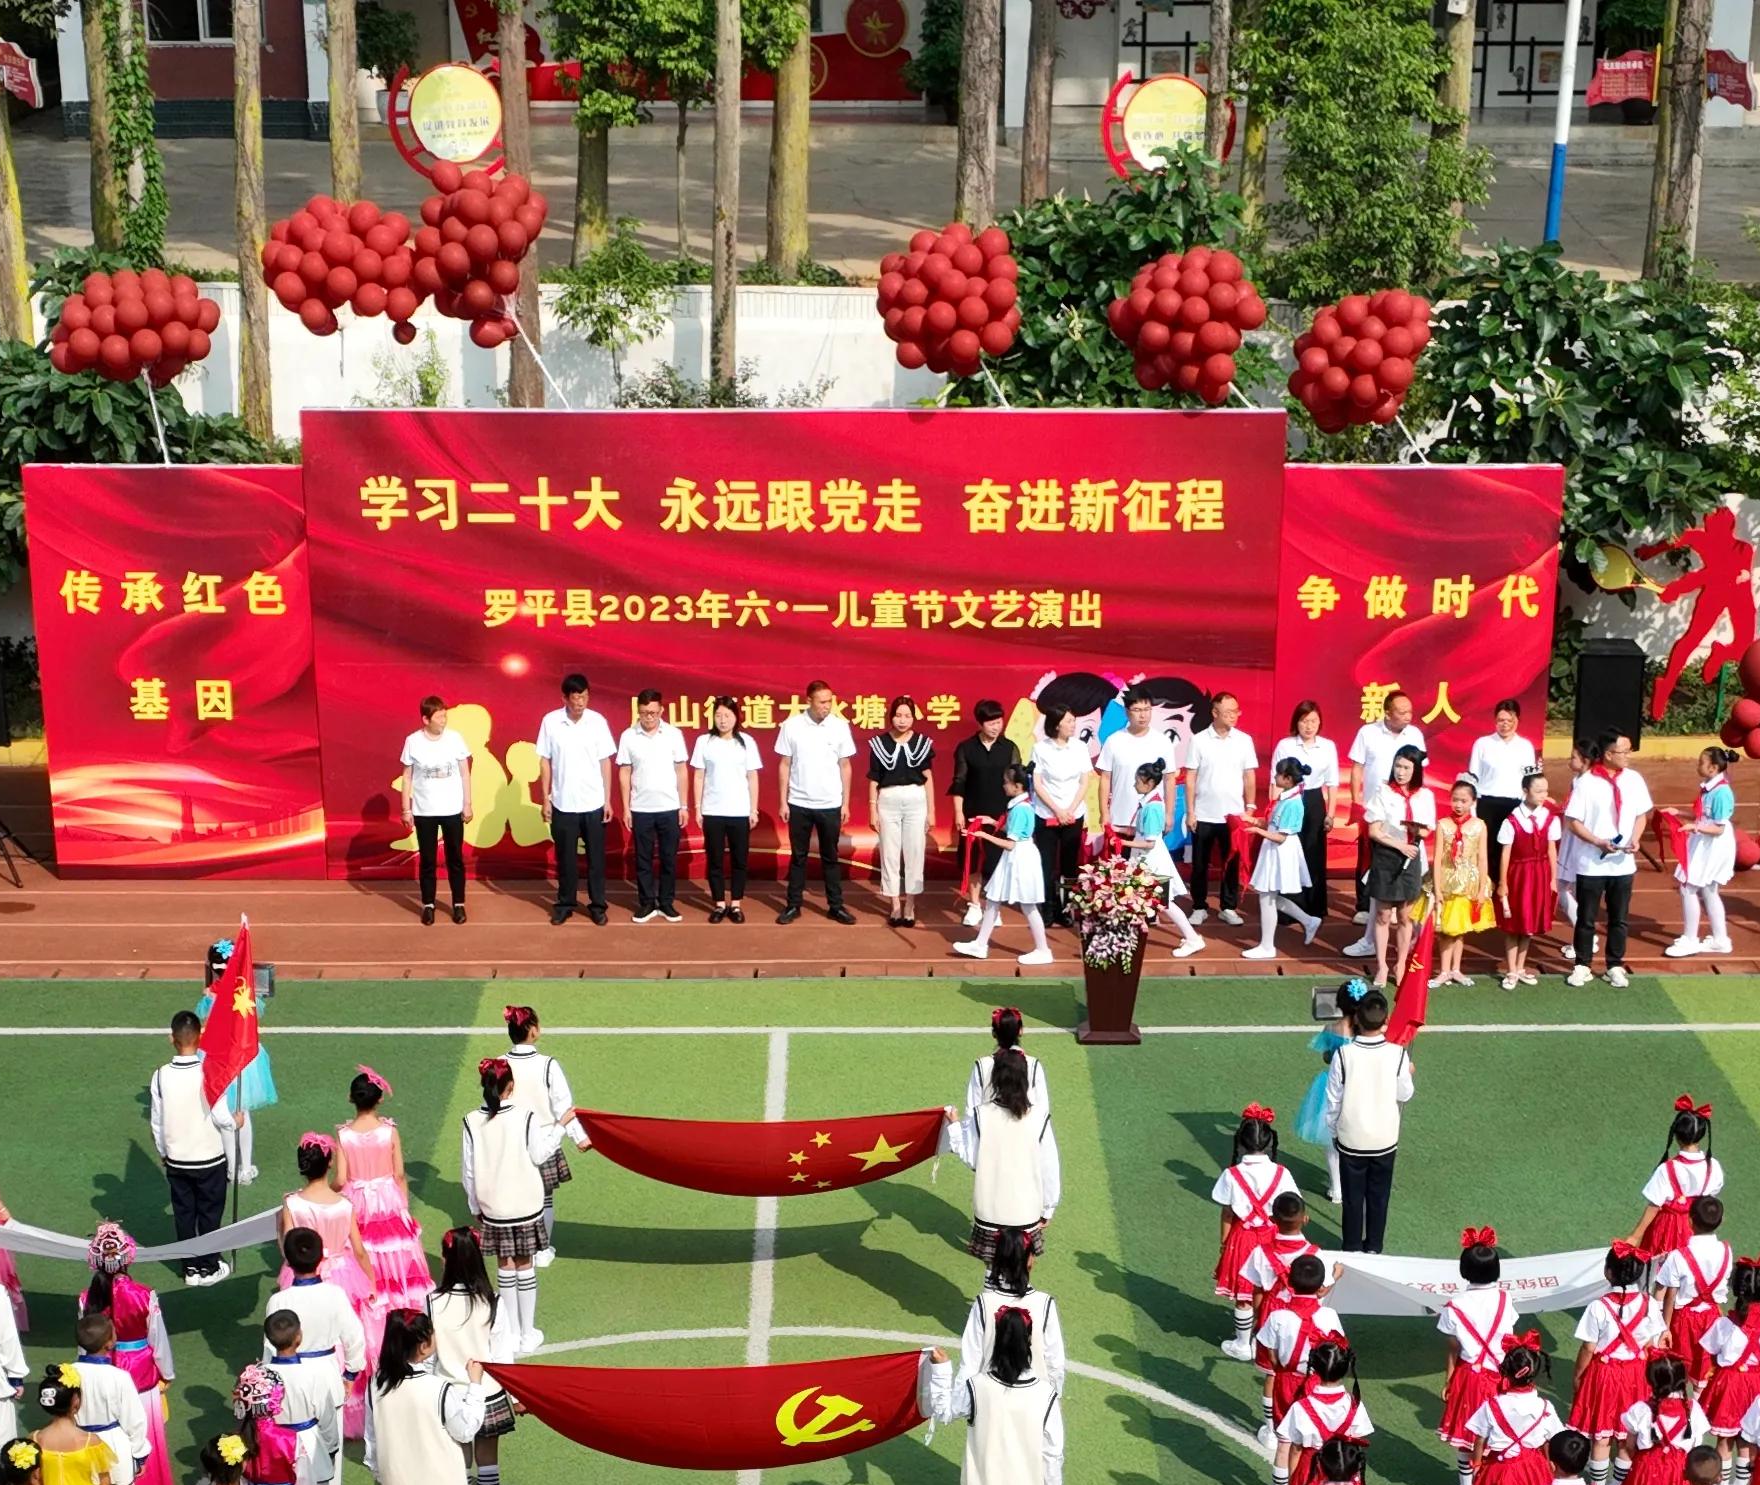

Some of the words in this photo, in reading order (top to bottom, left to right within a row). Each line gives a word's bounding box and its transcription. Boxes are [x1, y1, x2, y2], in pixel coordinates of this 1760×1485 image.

[359, 475, 622, 532] 学习二十大
[660, 476, 922, 533] 永远跟党走
[962, 478, 1225, 533] 奋进新征程
[59, 570, 286, 615] 传承红色
[1296, 574, 1539, 620] 争做时代
[129, 677, 234, 721] 基因
[1359, 681, 1462, 724] 新人
